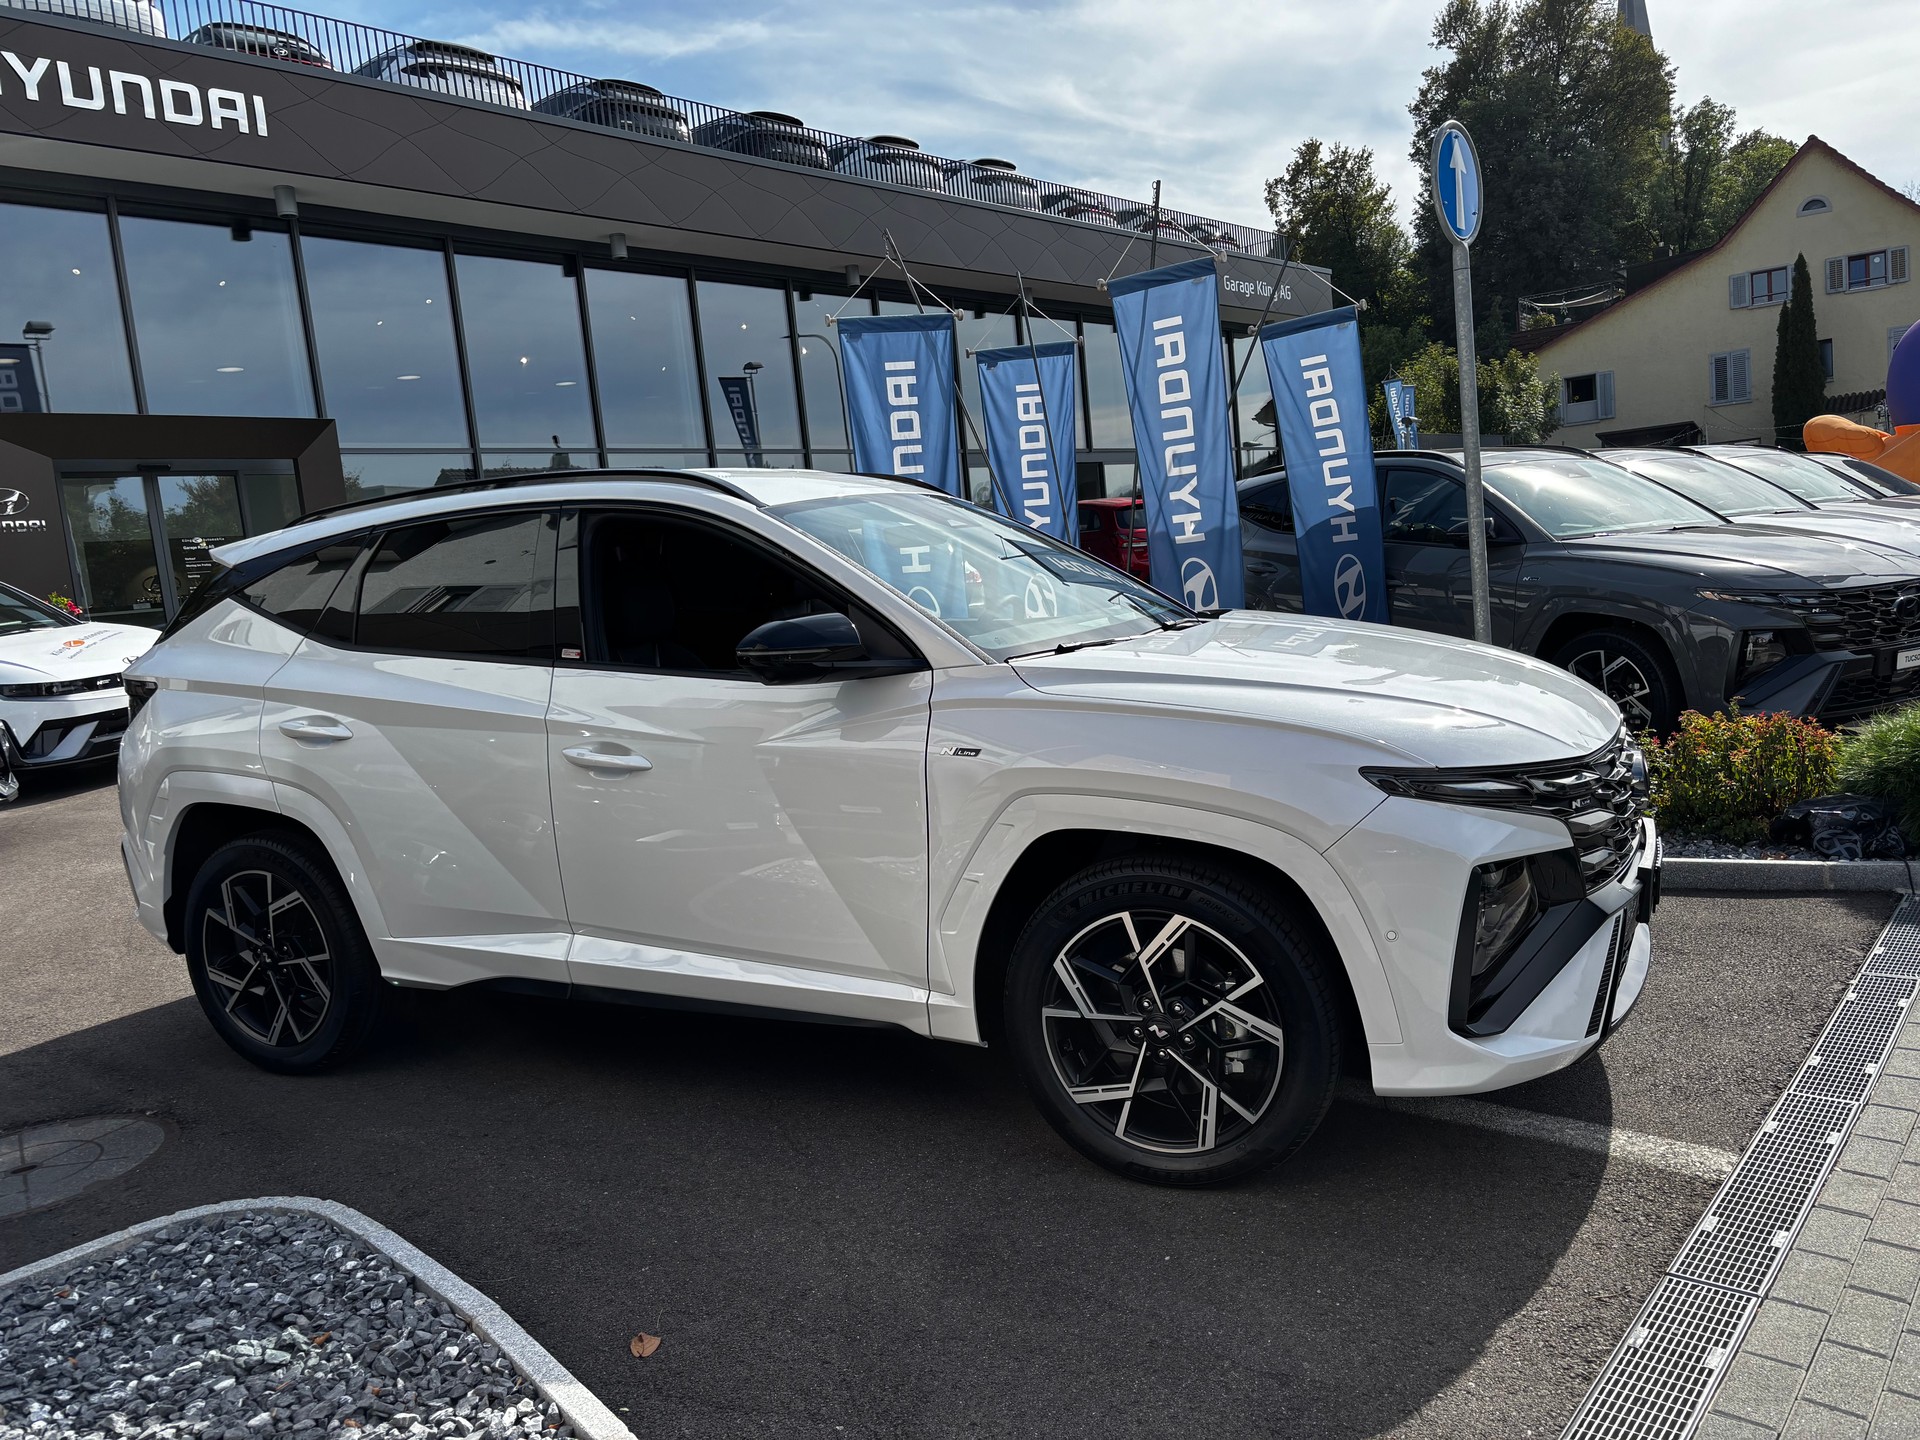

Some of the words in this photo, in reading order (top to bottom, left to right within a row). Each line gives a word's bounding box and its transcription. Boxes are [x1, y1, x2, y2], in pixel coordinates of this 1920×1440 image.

[0, 51, 267, 137] YUNDAI
[1223, 275, 1255, 297] Garage
[1280, 284, 1292, 300] AG
[1015, 383, 1051, 529] YUNDAI
[0, 520, 47, 532] NDAI
[940, 747, 957, 756] N
[1078, 881, 1185, 908] MICHELIN
